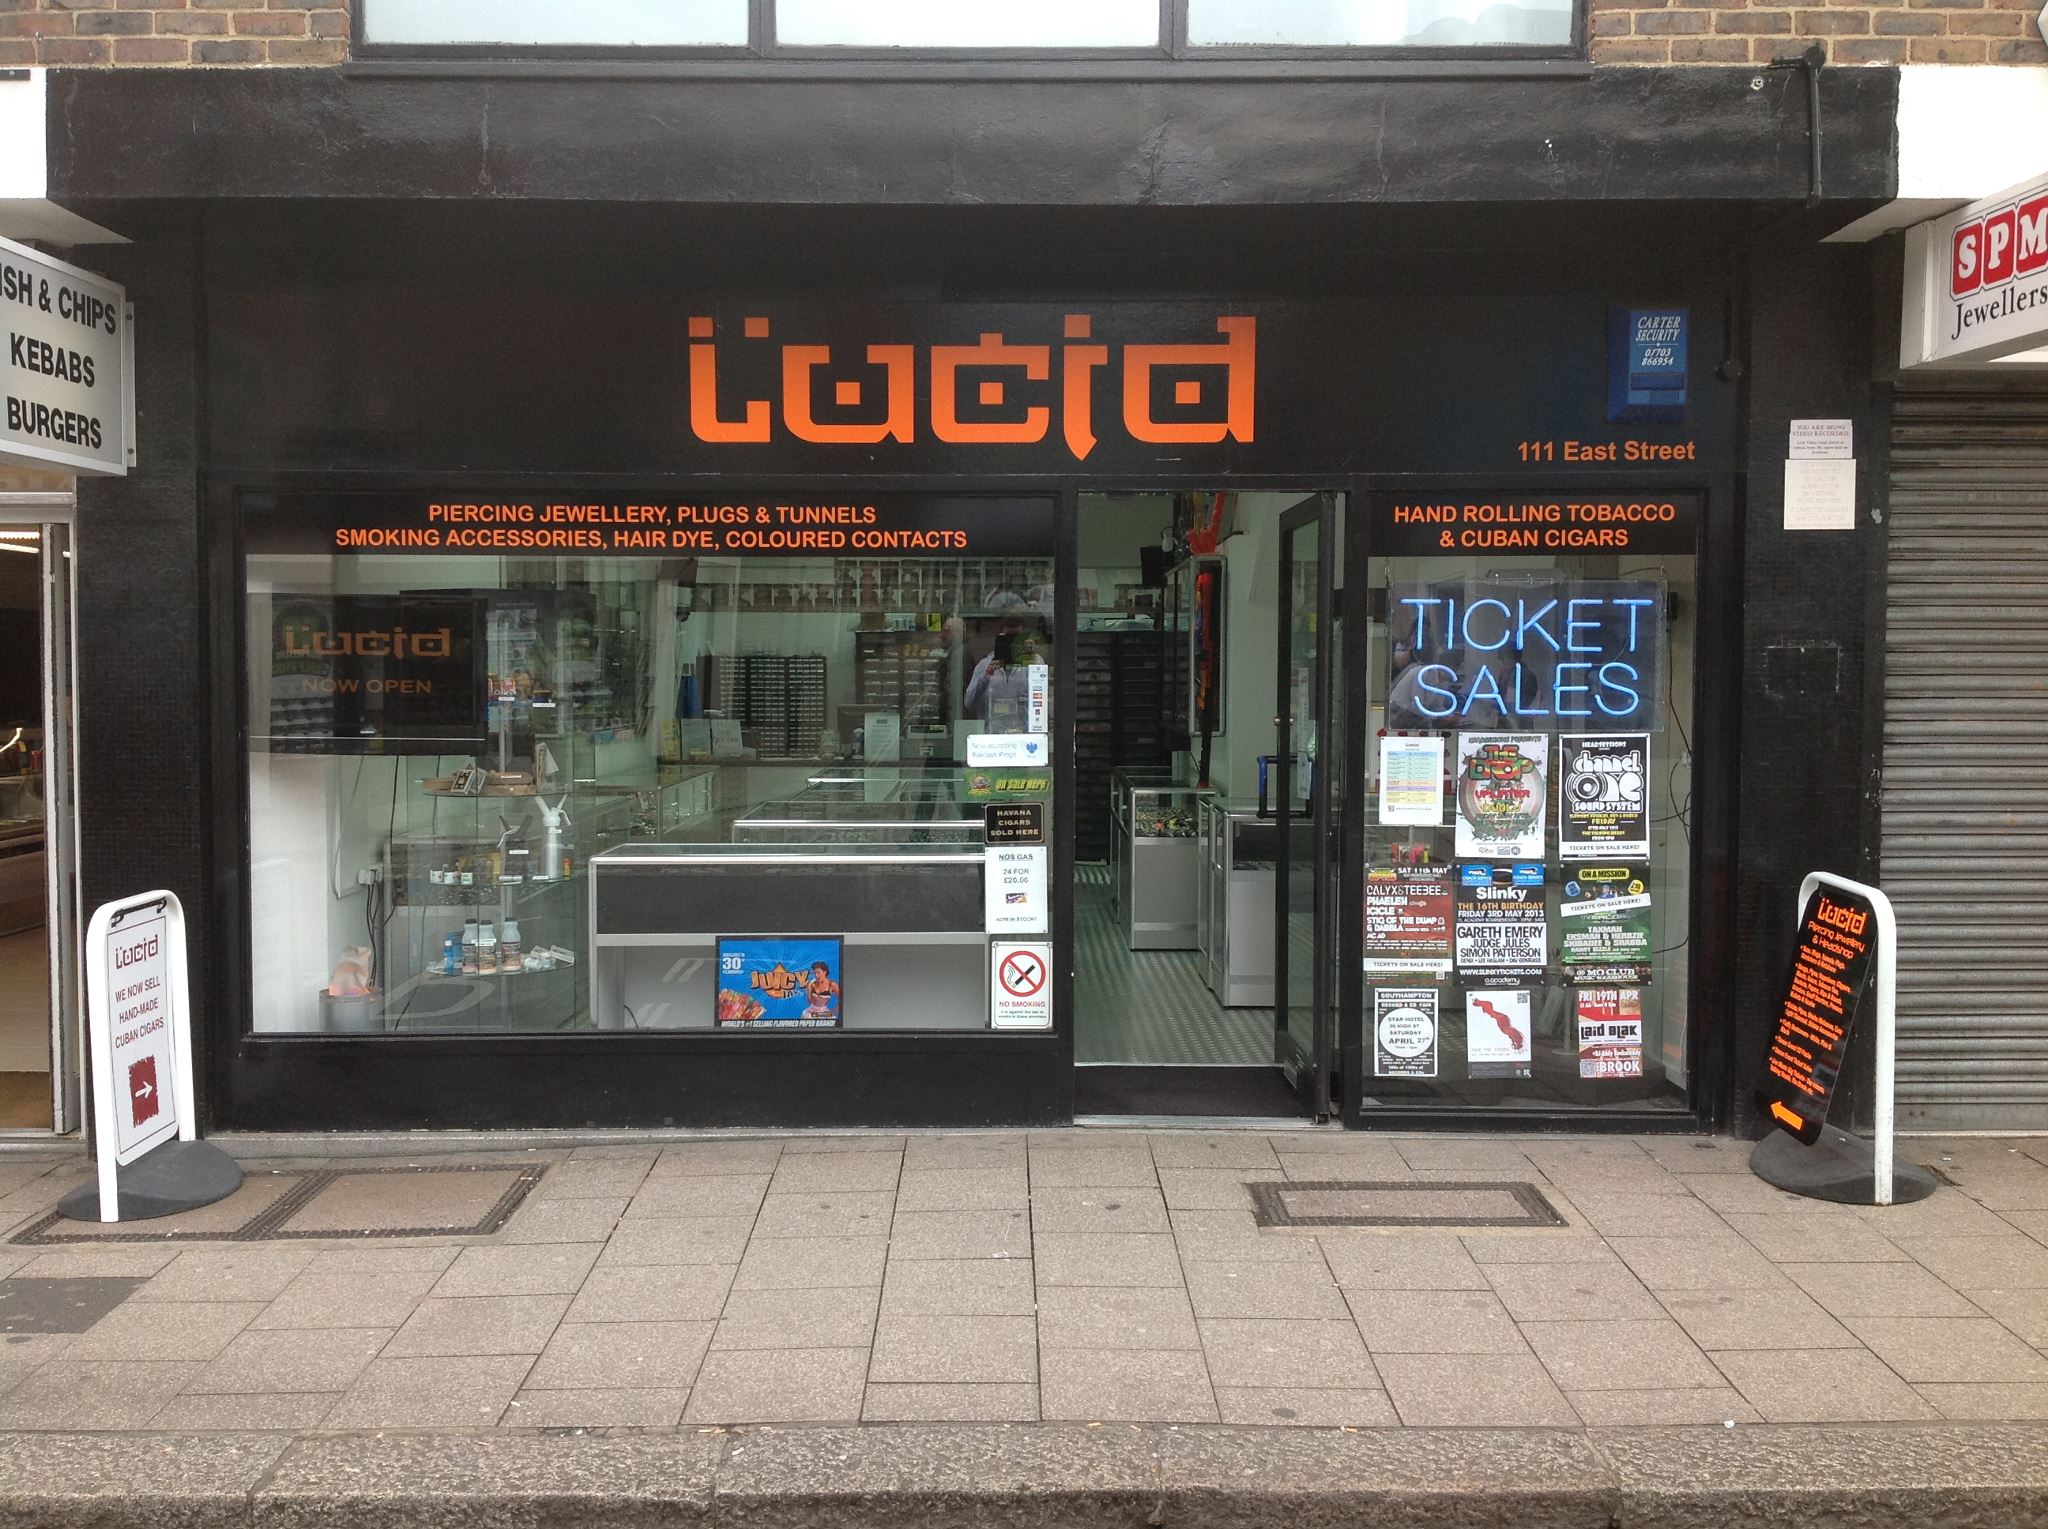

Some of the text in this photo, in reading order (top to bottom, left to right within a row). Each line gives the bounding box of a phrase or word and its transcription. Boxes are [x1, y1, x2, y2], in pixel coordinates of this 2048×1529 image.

[1957, 206, 2048, 280] SPM
[38, 278, 52, 314] &
[58, 286, 117, 335] CHIPS
[1951, 284, 2048, 341] Jewellers
[1637, 316, 1681, 329] CARTER
[1635, 329, 1681, 341] SECURITY
[10, 332, 96, 388] KEBABS
[6, 395, 102, 450] BURGERS
[1518, 440, 1696, 461] 111 East Street
[429, 504, 877, 526] PIERCING JEWELLERY, PLUGS & TUNNELS
[1394, 503, 1676, 523] HAND ROLLING TOBACCO
[335, 528, 967, 551] SMOKING ACCESSORIES, HAIR DYE, COLOURED CONTACTS
[1439, 529, 1629, 548] & CUBAN CIGARS
[1400, 598, 1653, 651] TICKET
[303, 679, 432, 694] NOW OPEN
[1413, 662, 1640, 716] SALES
[1582, 870, 1627, 878] ON A MISSION
[1476, 887, 1527, 902] Slinky
[1457, 910, 1485, 918] FRIDAY
[1477, 902, 1499, 910] 16TH
[1501, 902, 1544, 910] BIRTHDAY
[1457, 926, 1502, 938] GARETH
[1504, 926, 1544, 938] EMERY
[1808, 920, 1865, 953] Piercing Jewellery
[1460, 947, 1541, 957] SIMON PATTERSON
[1470, 938, 1530, 948] JUDGE JULES
[1812, 934, 1818, 944] &
[1819, 937, 1854, 959] Headshop
[750, 970, 810, 990] JUICY
[1606, 968, 1635, 976] CLUB
[115, 976, 161, 1004] WE NOW SELL
[1579, 990, 1639, 1001] FRI 19TH APR
[119, 997, 159, 1024] HAND-MADE
[115, 1016, 164, 1049] CUBAN CIGARS
[1388, 1037, 1415, 1045] APRIL
[1599, 1061, 1640, 1072] BROOK
